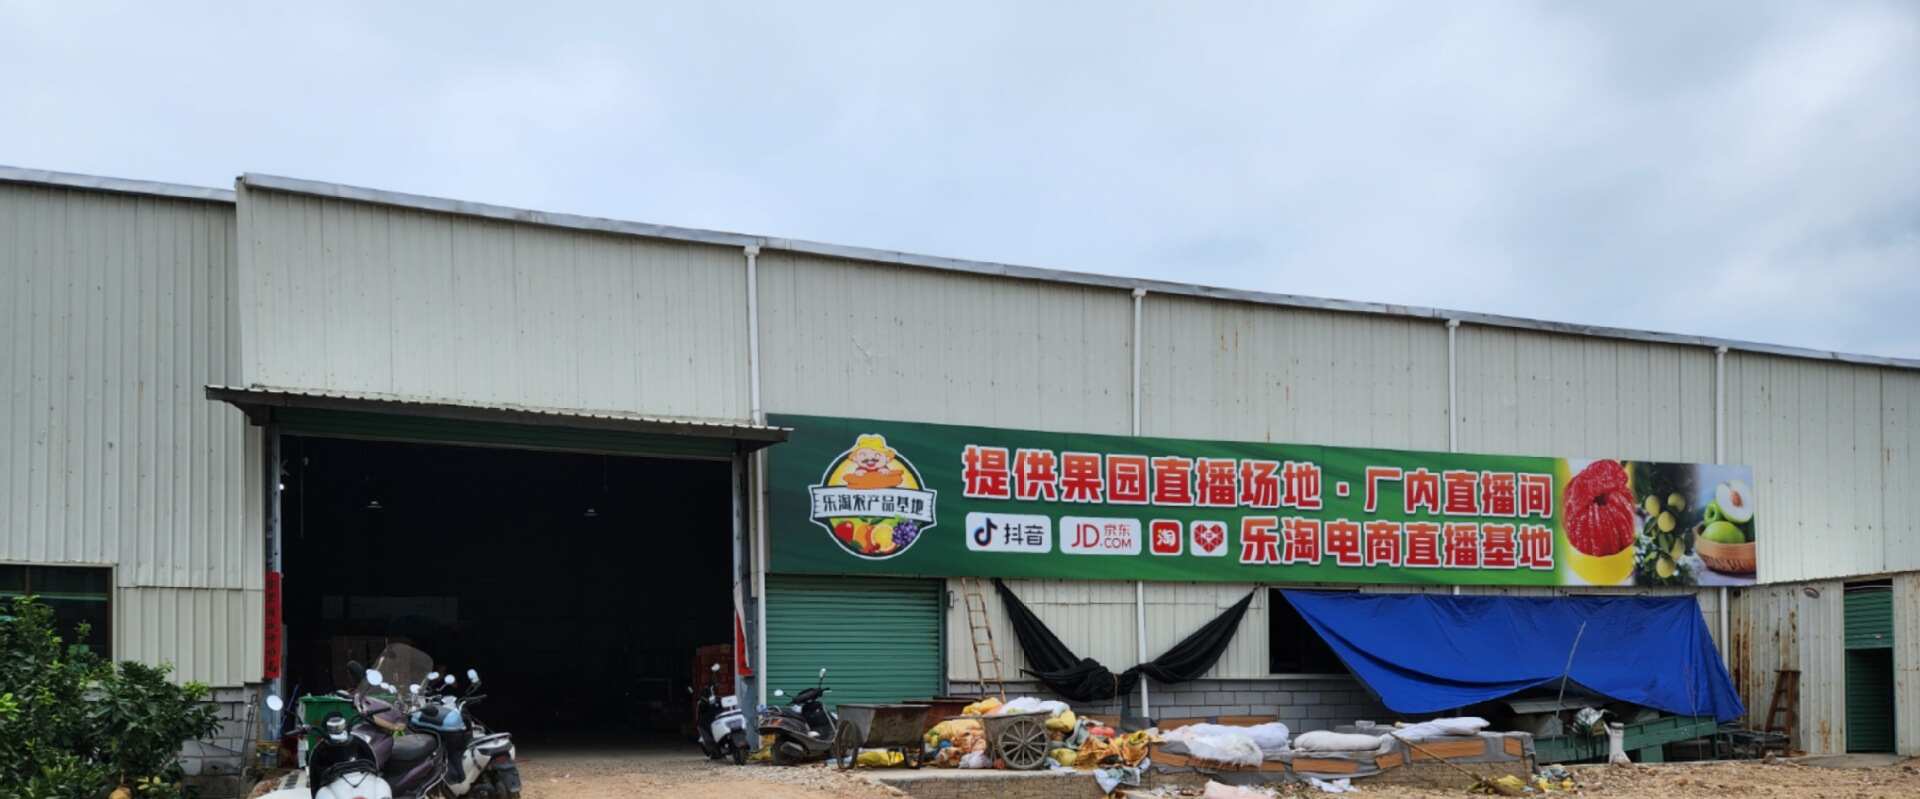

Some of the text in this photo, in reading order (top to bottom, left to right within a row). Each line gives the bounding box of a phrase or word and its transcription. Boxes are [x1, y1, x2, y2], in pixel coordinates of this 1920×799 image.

[962, 445, 1554, 518] 提供果园直播场地·厂内直播间
[822, 494, 924, 514] 乐淘农产品基地
[1004, 523, 1044, 546] 抖音
[1104, 523, 1131, 537] 京东
[1156, 528, 1177, 547] 淘
[1239, 516, 1554, 571] 乐淘电商直播基地
